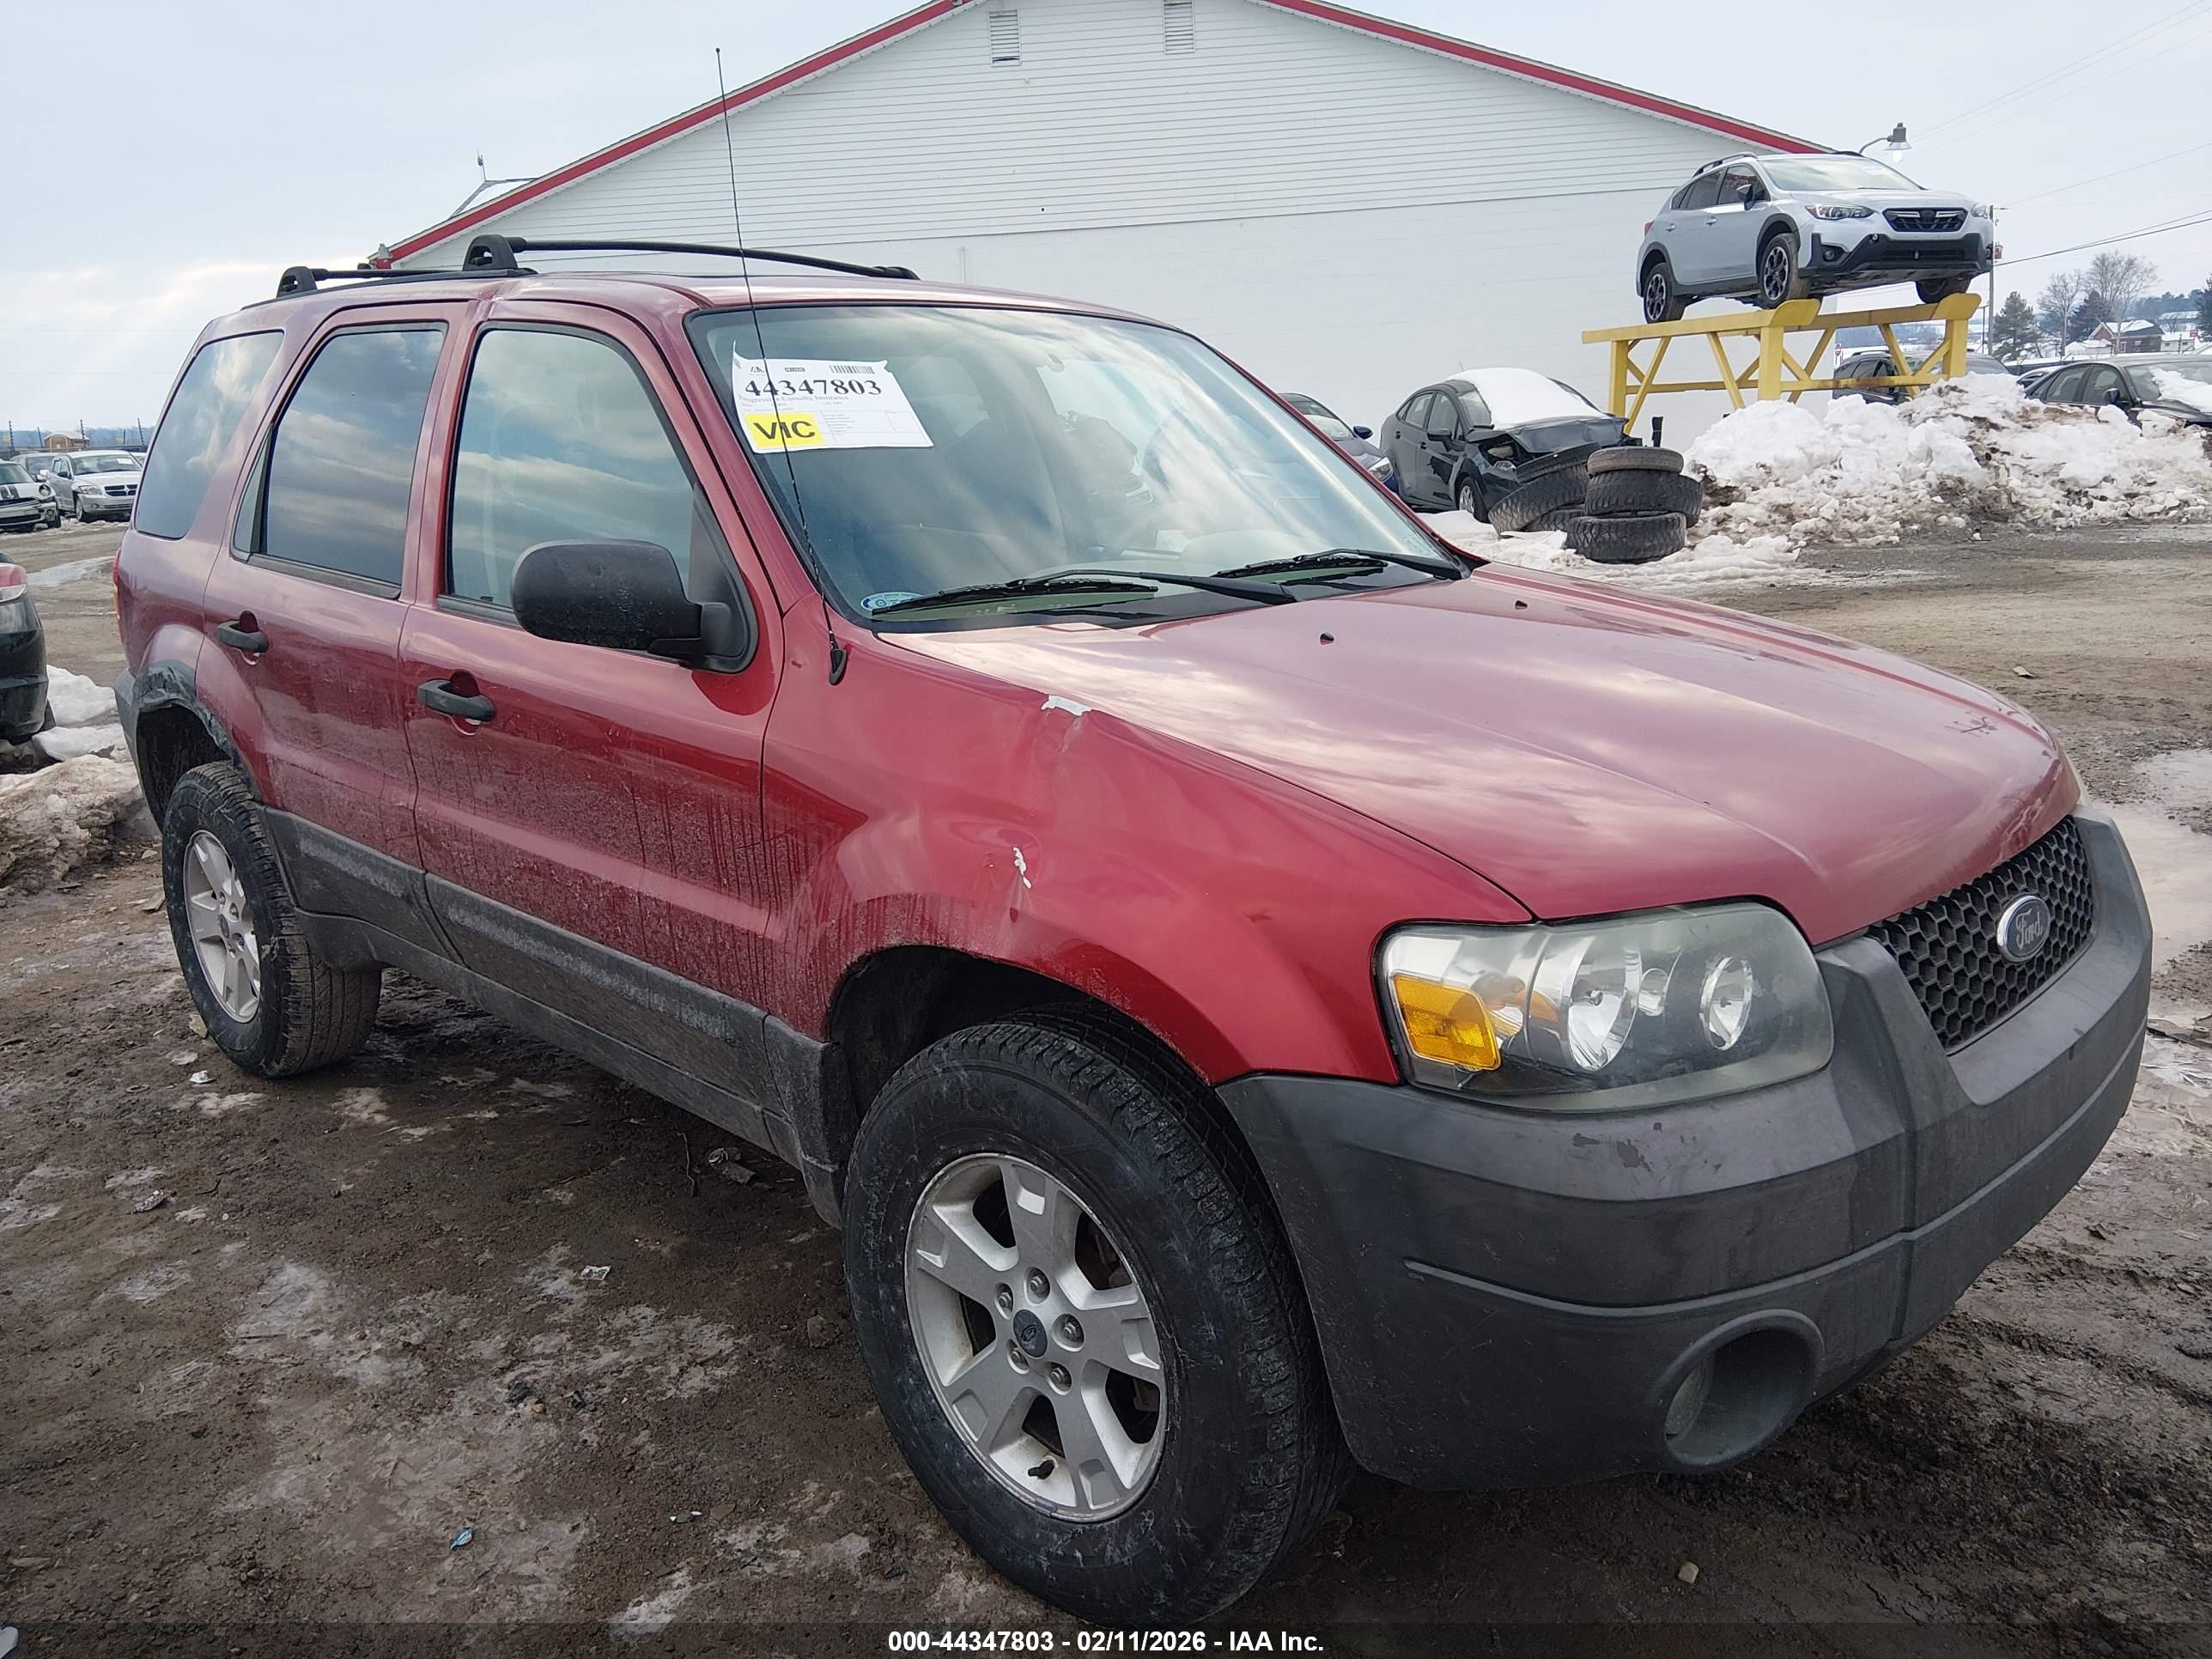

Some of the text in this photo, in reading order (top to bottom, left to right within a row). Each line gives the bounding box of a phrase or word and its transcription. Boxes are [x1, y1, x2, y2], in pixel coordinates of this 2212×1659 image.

[745, 380, 882, 396] 44347803
[753, 421, 815, 439] VIC
[2015, 908, 2044, 950] Ford
